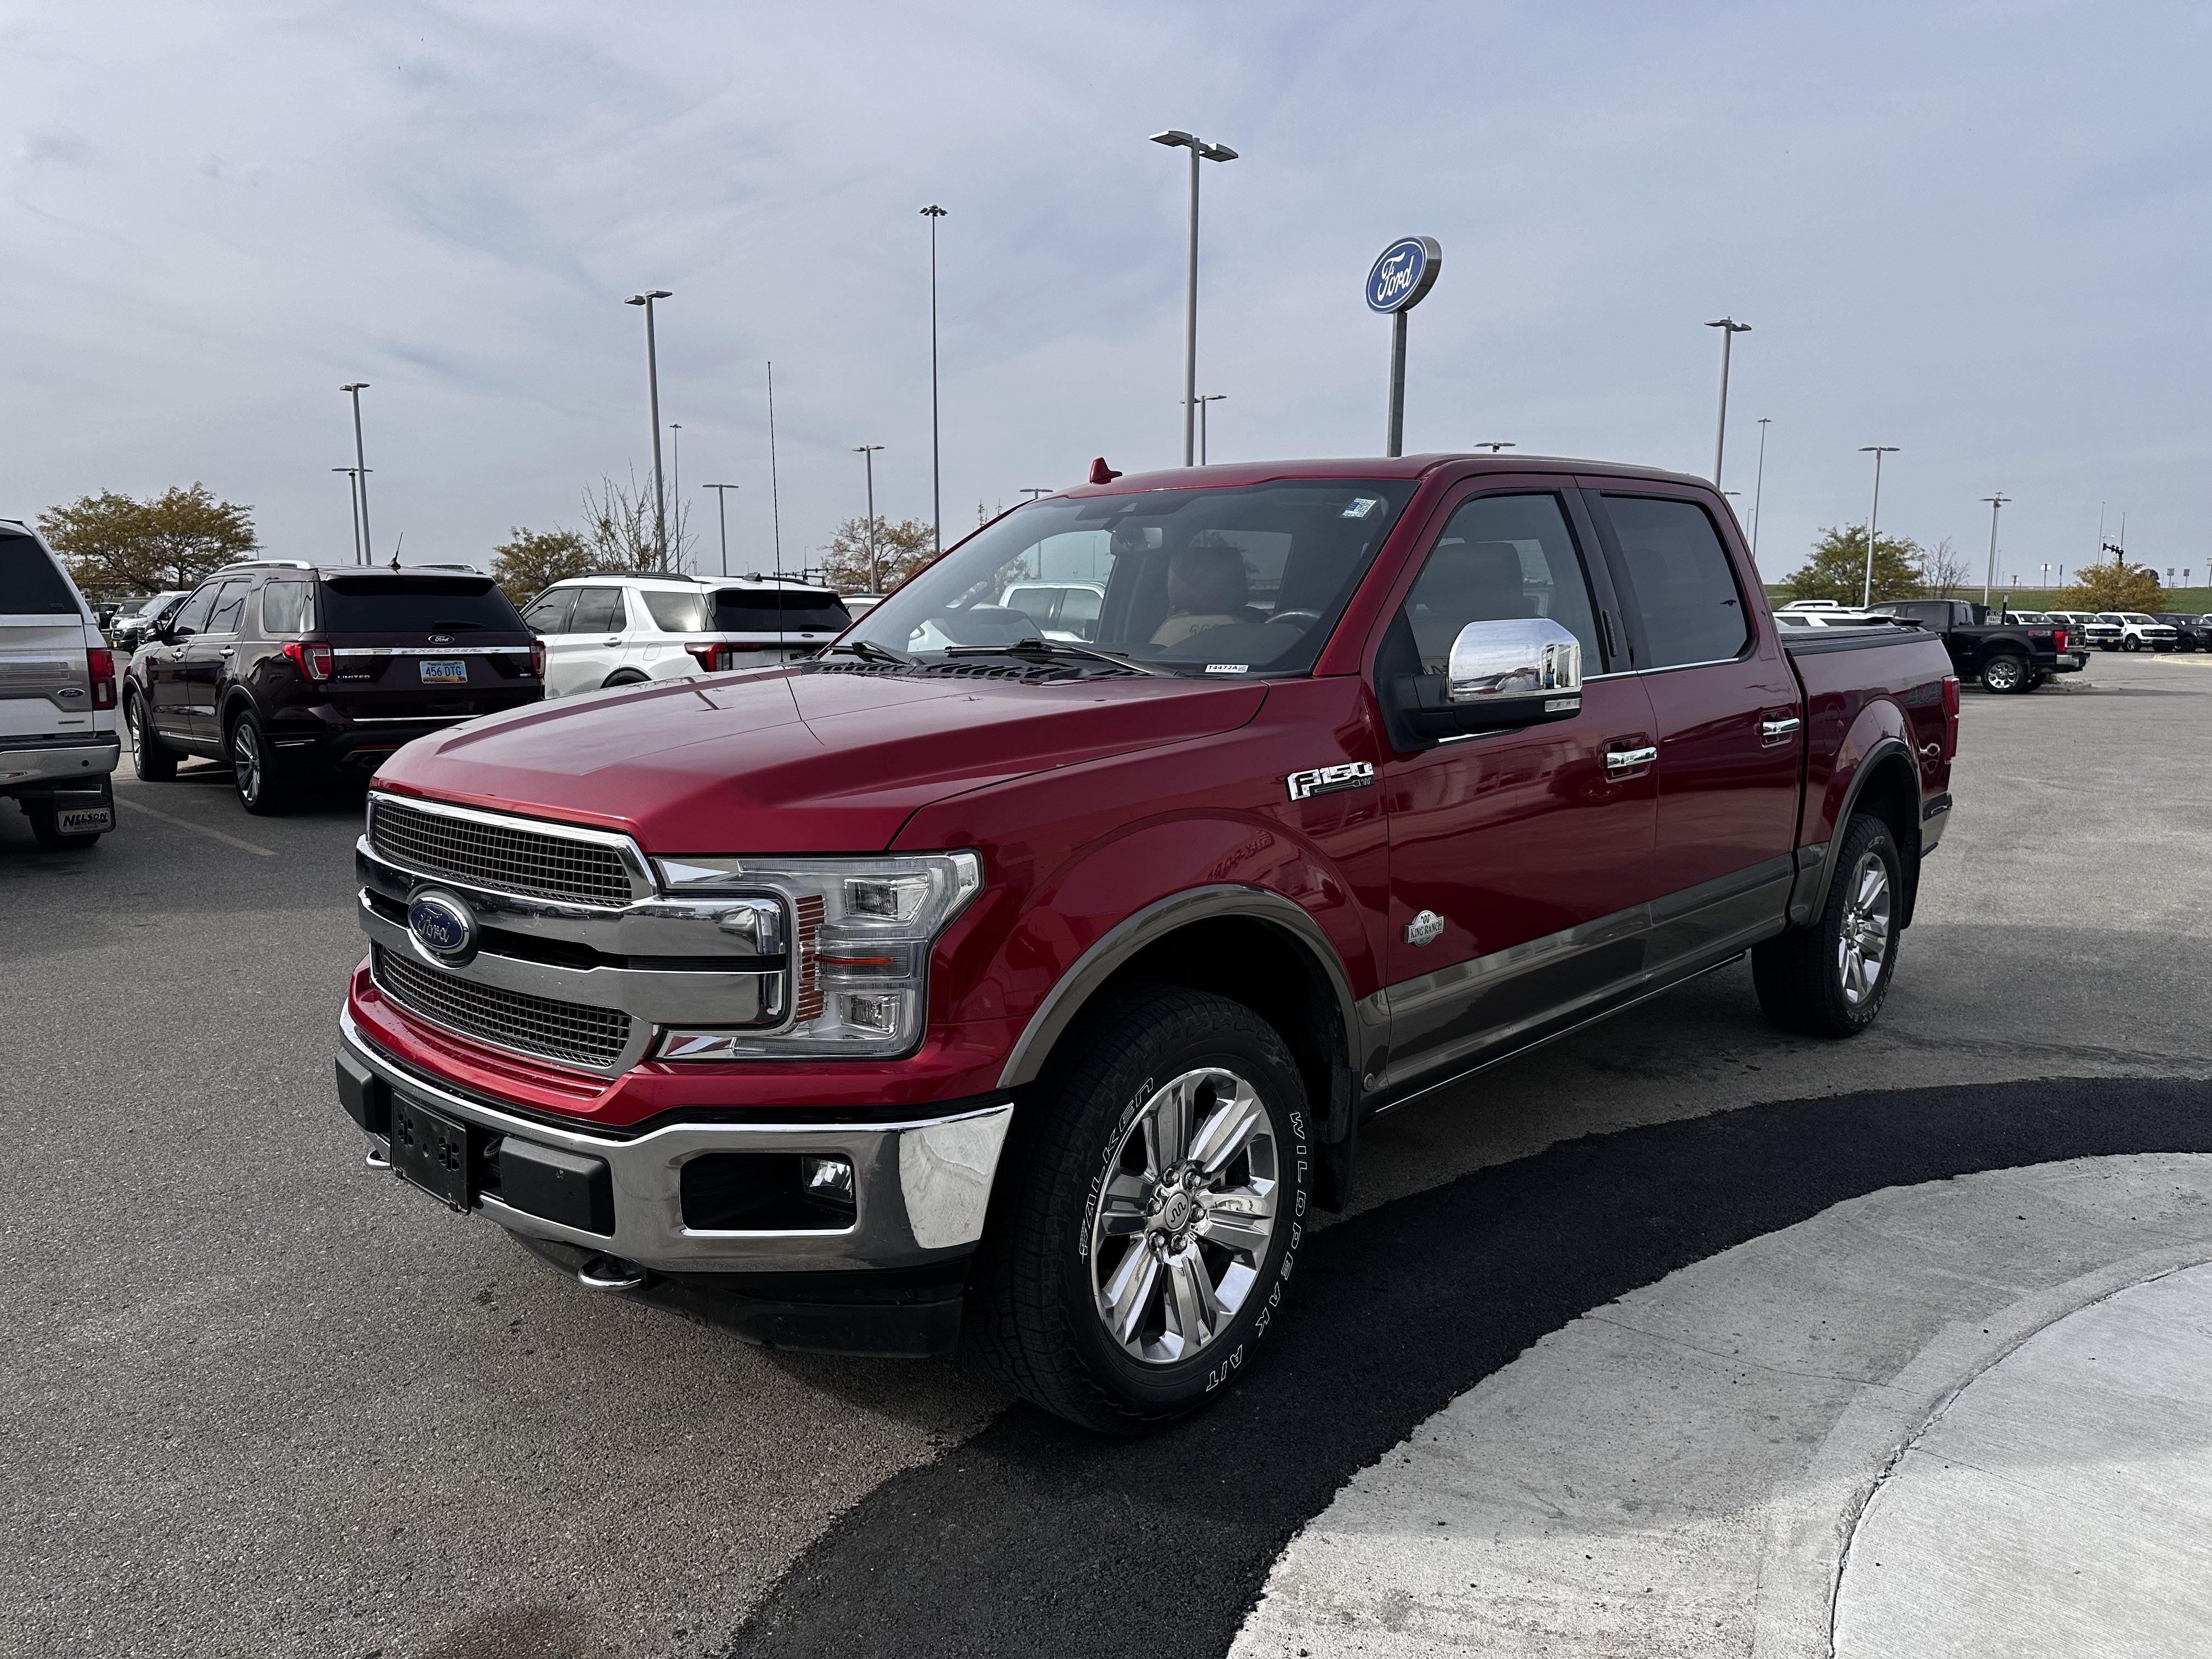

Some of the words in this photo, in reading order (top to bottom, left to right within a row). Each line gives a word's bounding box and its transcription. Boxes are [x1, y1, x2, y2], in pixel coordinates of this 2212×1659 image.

[1377, 251, 1414, 302] Ford
[426, 667, 442, 676] 456
[444, 666, 461, 676] DTG
[63, 812, 107, 827] NELSON
[417, 907, 450, 943] Ford
[1410, 926, 1424, 939] KING
[1424, 919, 1442, 934] RANCH
[1079, 1077, 1153, 1264] FALKEN
[1255, 1111, 1308, 1338] WILDPEAK
